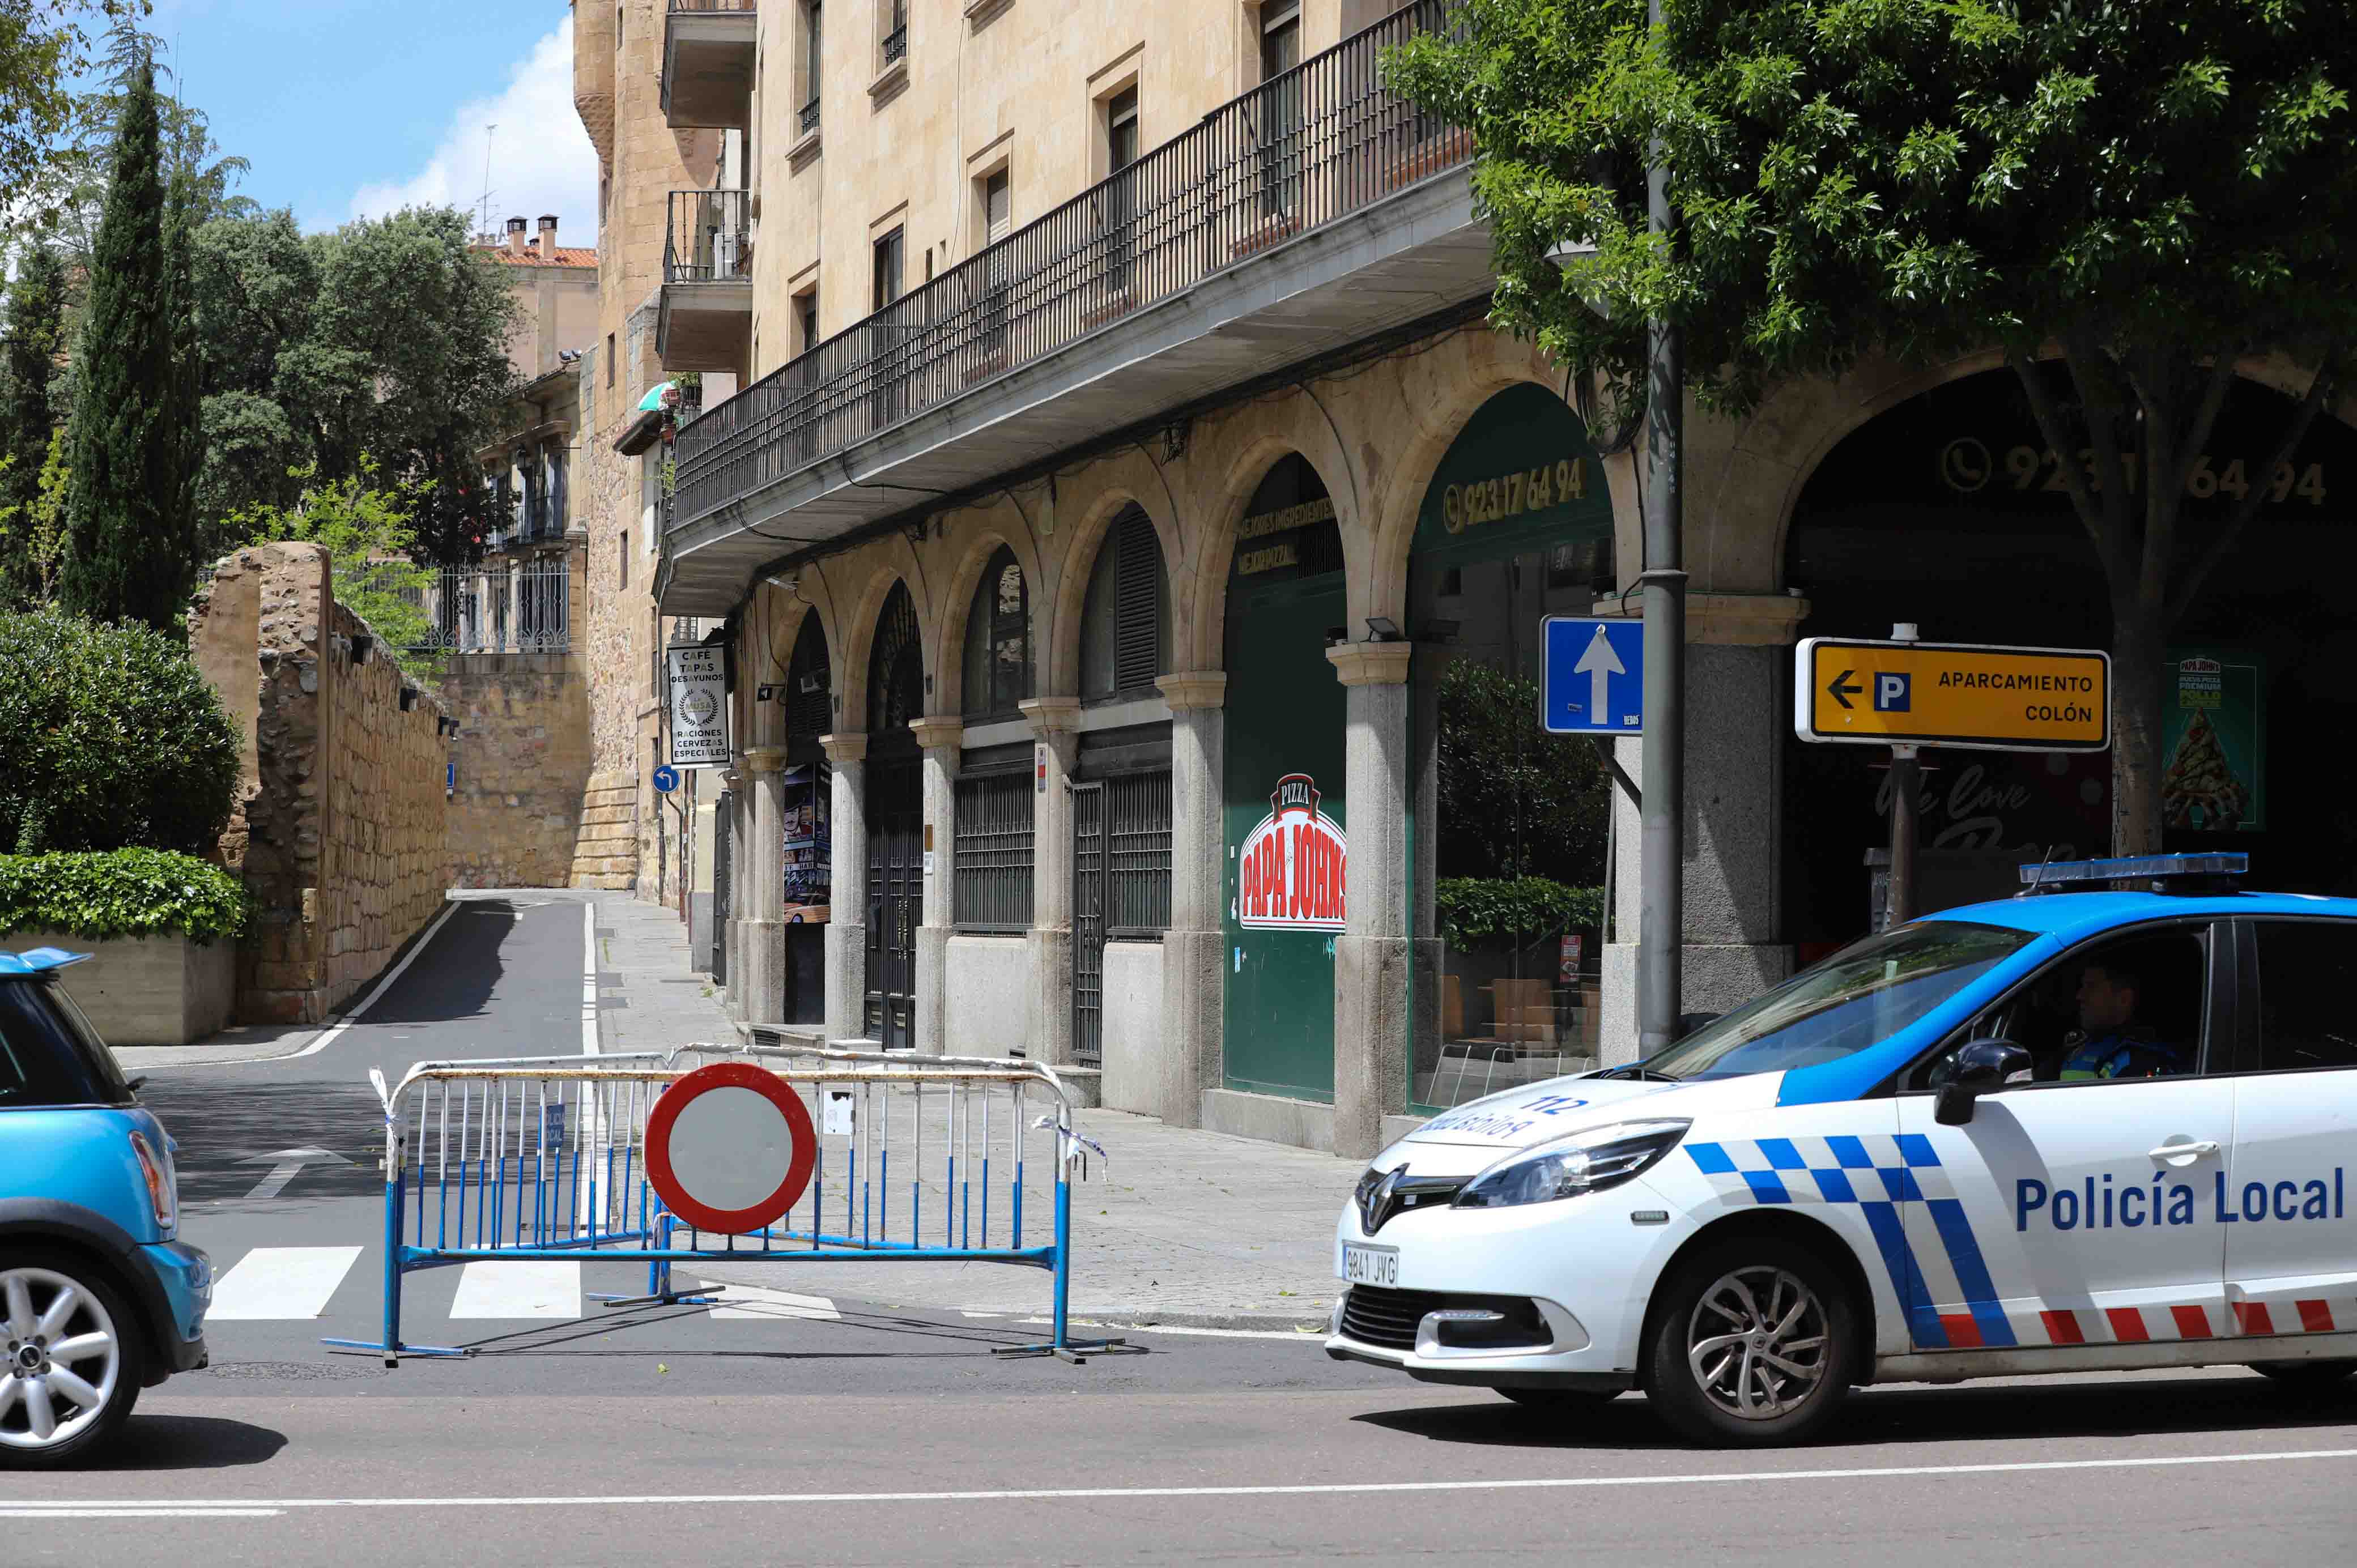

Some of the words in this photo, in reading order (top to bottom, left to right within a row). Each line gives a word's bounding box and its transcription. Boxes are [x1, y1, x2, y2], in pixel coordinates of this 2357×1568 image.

[2188, 454, 2249, 501] 64
[2270, 461, 2327, 506] 94
[1465, 478, 1499, 526] 923
[1505, 472, 1523, 517] 17
[1527, 466, 1551, 512] 64
[1555, 457, 1585, 503] 94
[682, 649, 711, 660] CAFÉ
[671, 673, 724, 683] DESAYUNOS
[680, 663, 714, 673] TAPAS
[1938, 671, 2093, 692] APARCAMIENTO
[1881, 676, 1905, 708] P
[686, 701, 712, 710] MUSA
[2025, 702, 2092, 722] COLÓN
[677, 739, 722, 748] CERVEZAS
[678, 729, 722, 738] RACIONES
[674, 748, 726, 757] ESPECIALES
[1282, 782, 1309, 806] PIZZA
[1244, 826, 1287, 918] PAPA
[1520, 1096, 1589, 1115] 112
[2016, 1170, 2194, 1232] Policía
[2216, 1167, 2343, 1222] Local
[1348, 1250, 1368, 1281] 9841
[1375, 1254, 1396, 1285] JVG
